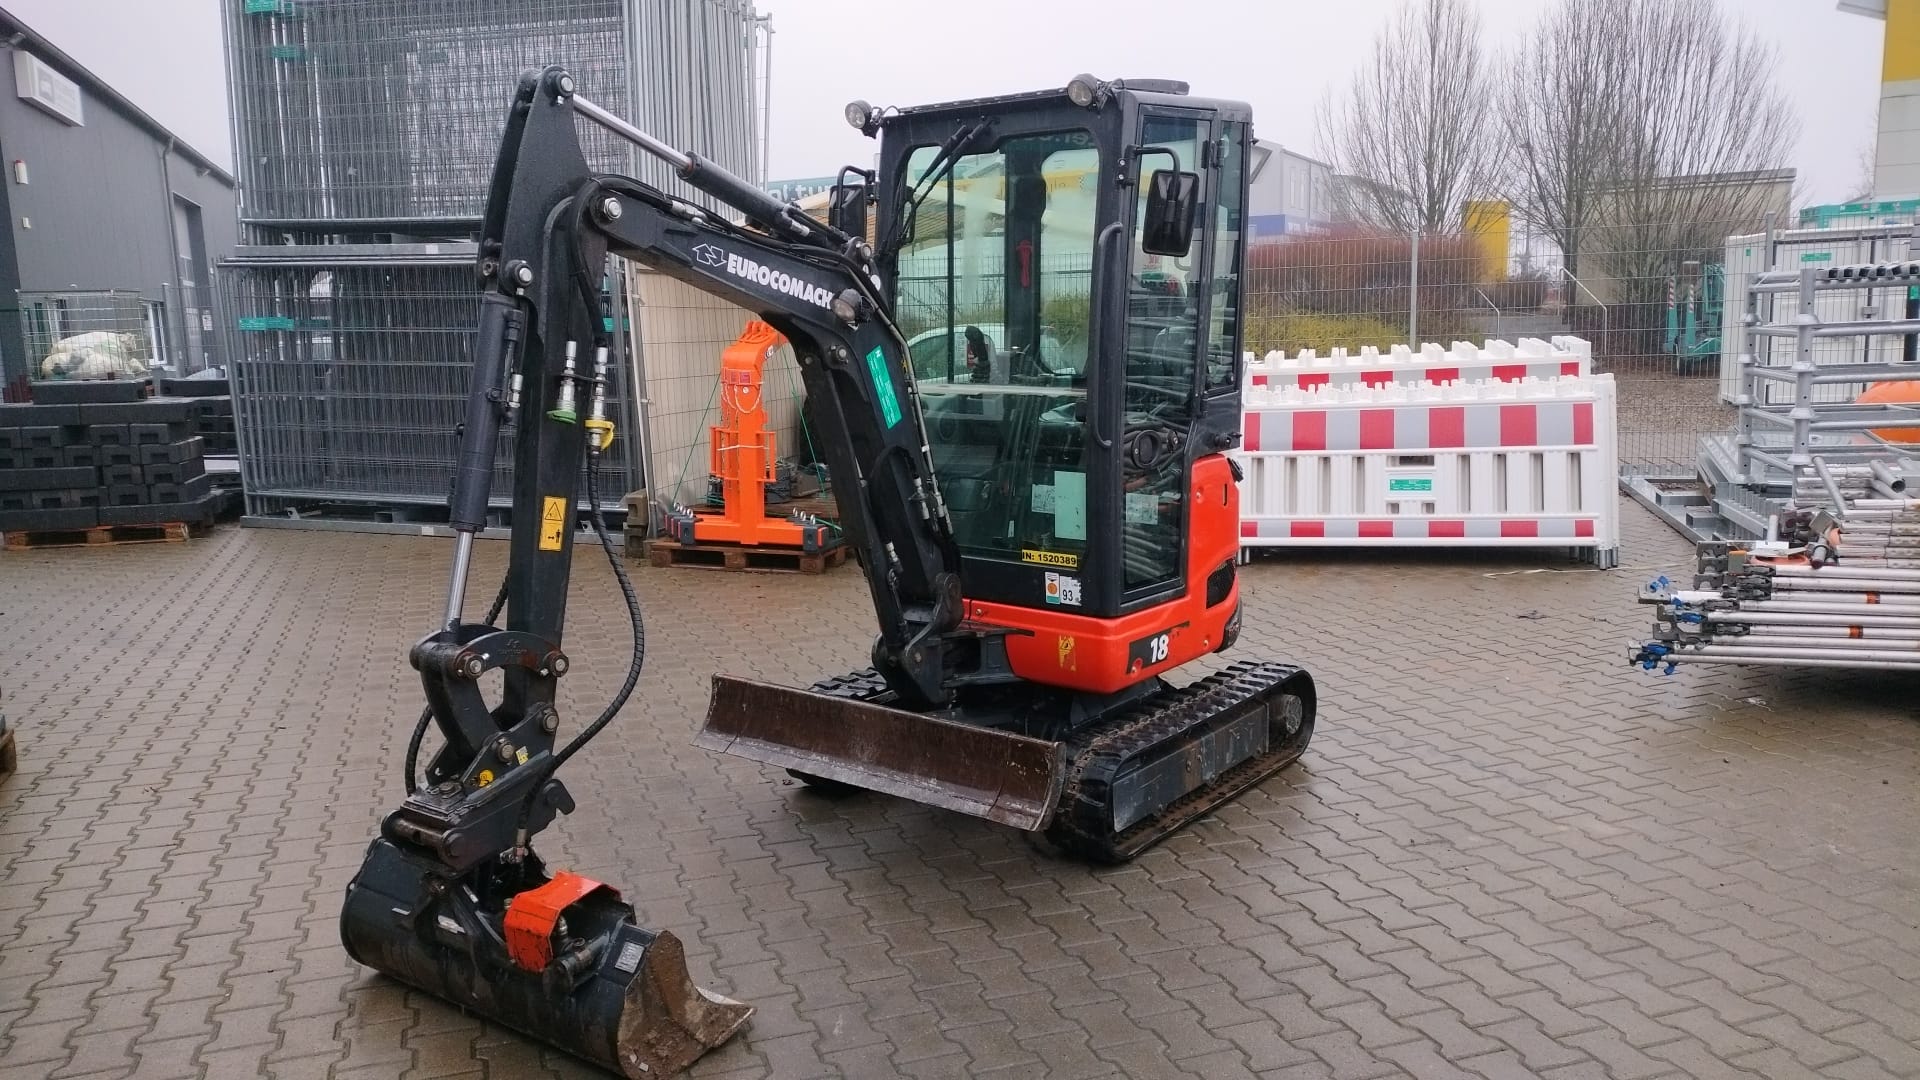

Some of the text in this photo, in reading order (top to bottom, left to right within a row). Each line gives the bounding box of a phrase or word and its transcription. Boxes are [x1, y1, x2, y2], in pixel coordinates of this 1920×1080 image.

[727, 252, 834, 310] EUROCOMACH
[1038, 553, 1077, 566] 1520389
[1062, 589, 1074, 602] 93
[1150, 634, 1169, 664] 18
